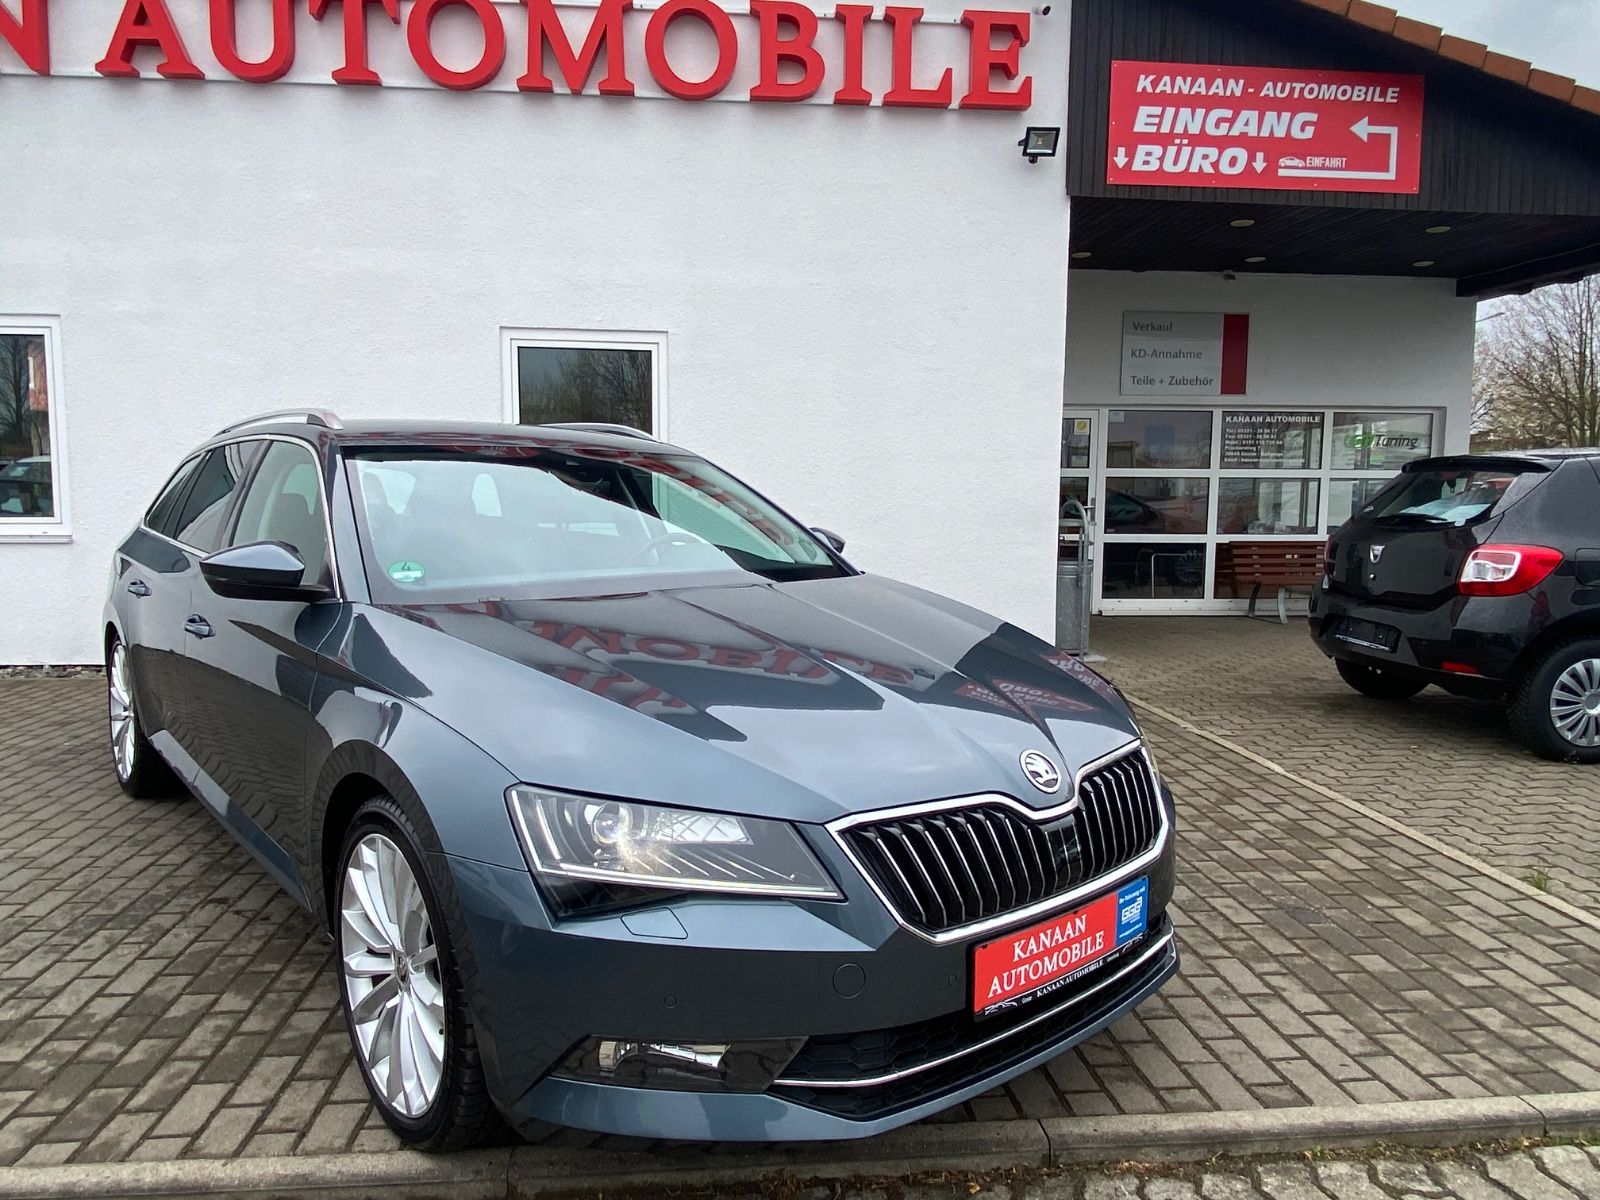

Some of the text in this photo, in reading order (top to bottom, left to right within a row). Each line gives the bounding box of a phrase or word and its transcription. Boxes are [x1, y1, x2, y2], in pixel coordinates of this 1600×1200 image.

[95, 0, 1032, 112] AUTOMOBILE
[1136, 74, 1244, 97] KANAAN
[1260, 81, 1400, 103] AUTOMOBILE
[1133, 105, 1318, 139] EINGANG
[1131, 138, 1249, 175] BÜRO
[1306, 156, 1347, 169] EINFAHRT
[1132, 321, 1174, 332] Verkauf
[1130, 348, 1203, 359] KD-Annahme
[1130, 375, 1156, 386] Teile
[1168, 375, 1214, 386] Zubehör
[1265, 415, 1321, 423] AUTOMOBILE
[1375, 434, 1418, 450] Tuning
[400, 561, 411, 571] 4
[1012, 914, 1087, 962] KANAAN
[987, 930, 1105, 998] AUTOMOBILE
